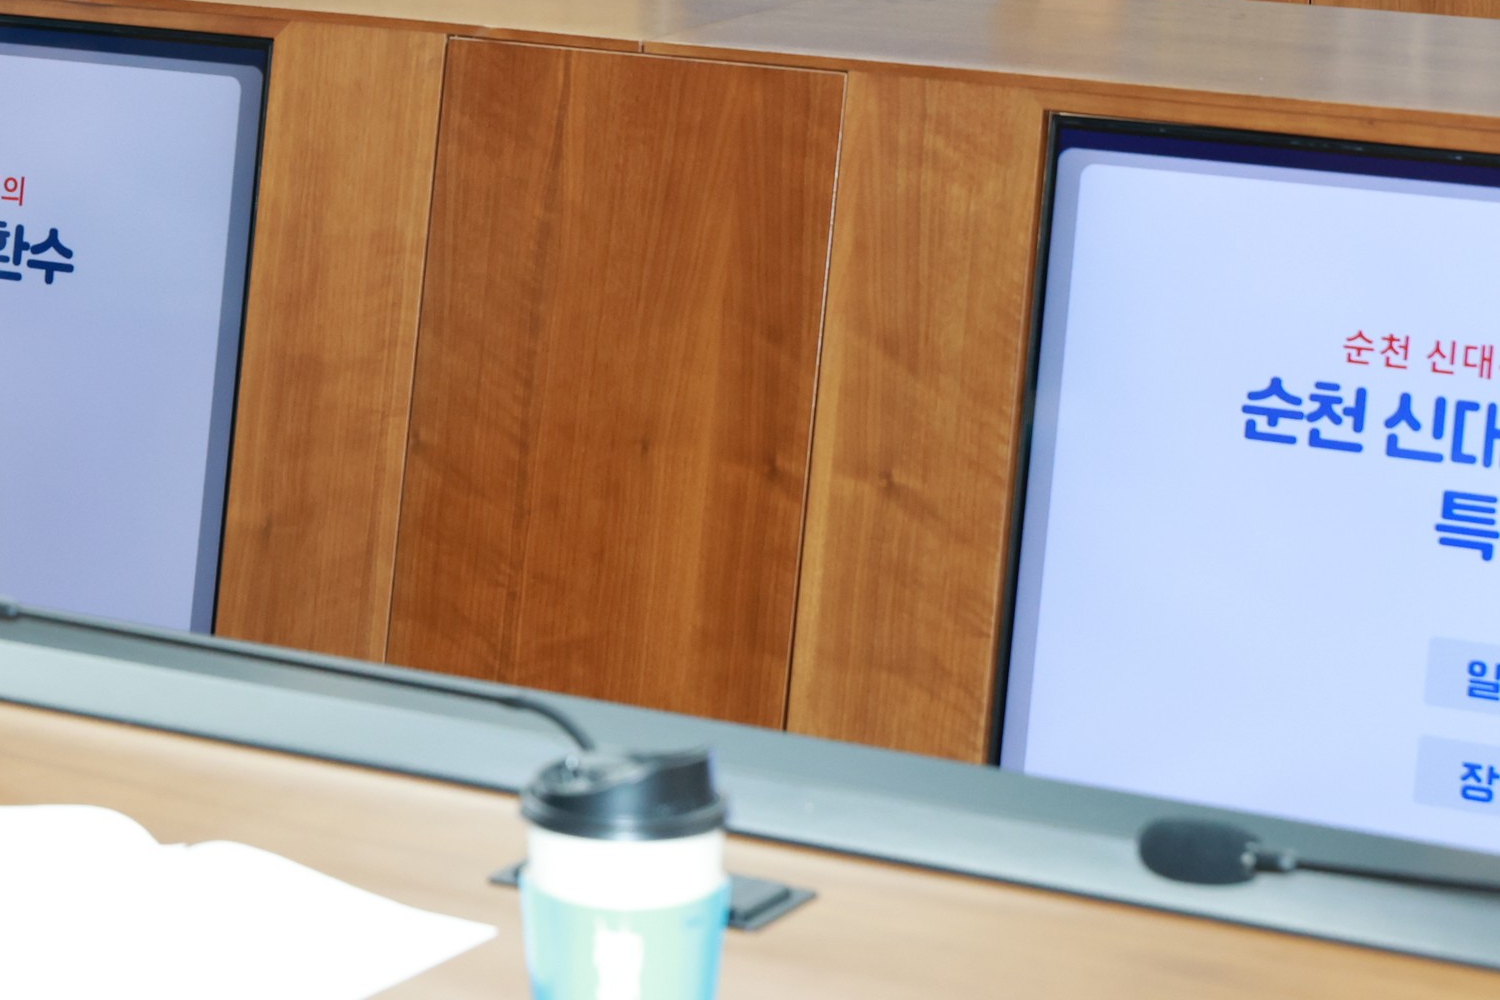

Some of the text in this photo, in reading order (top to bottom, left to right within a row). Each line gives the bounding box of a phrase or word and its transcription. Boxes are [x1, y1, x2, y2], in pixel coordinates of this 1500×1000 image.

[1343, 330, 1410, 369] 순천
[1241, 376, 1367, 453] 순천
[1435, 490, 1500, 562] 특
[1460, 761, 1500, 803] 장
